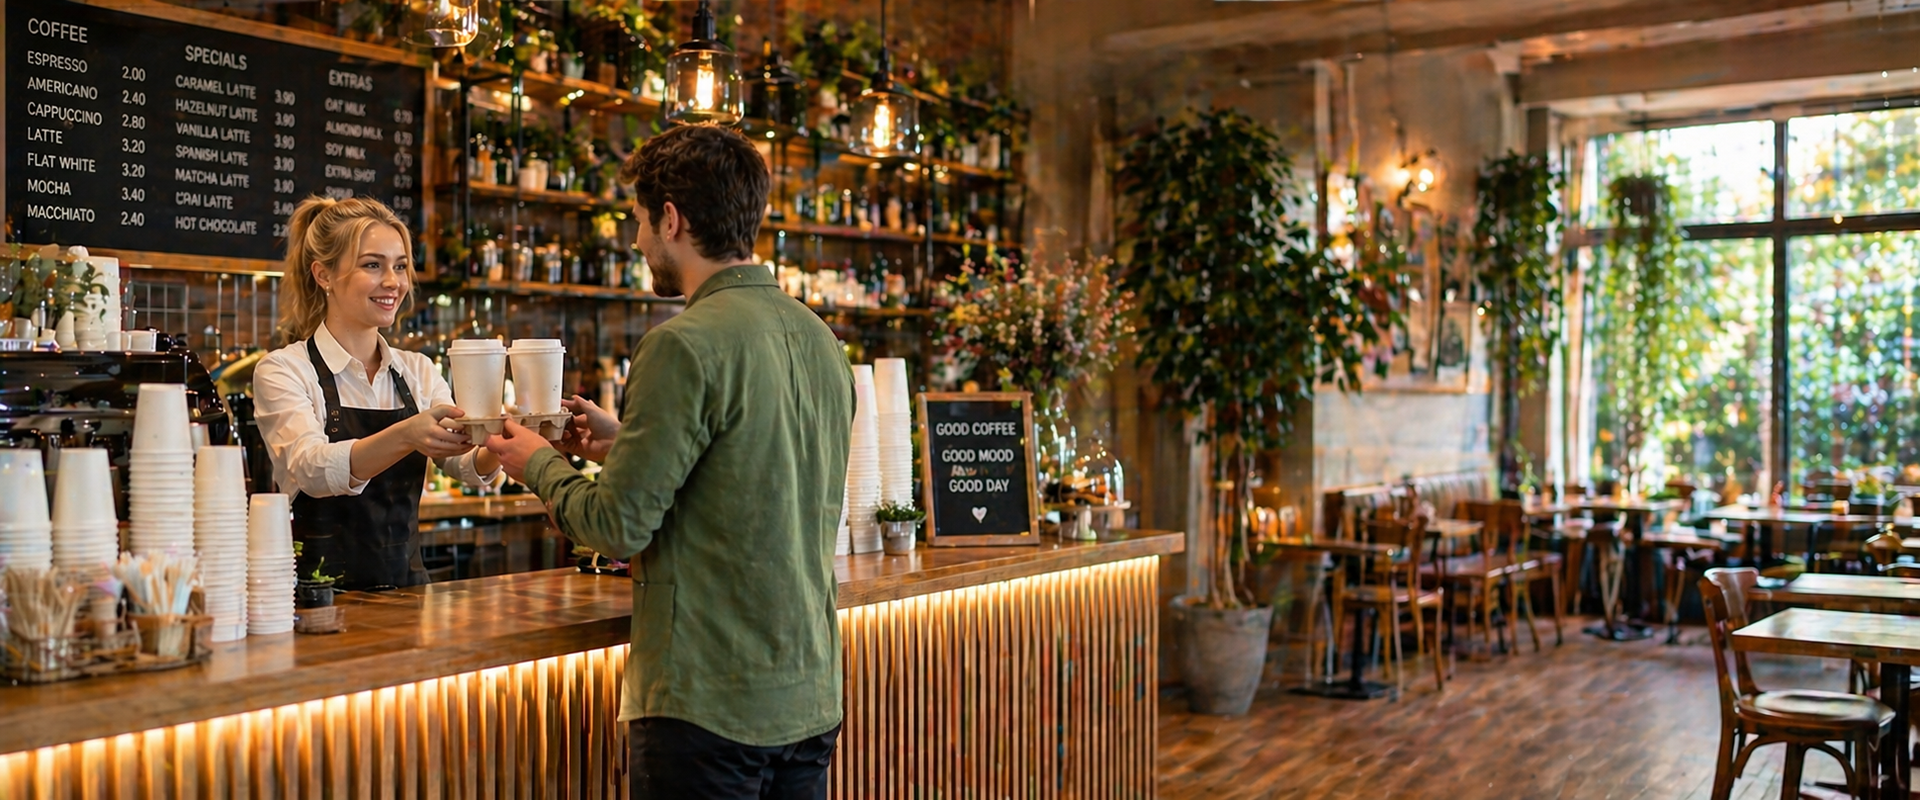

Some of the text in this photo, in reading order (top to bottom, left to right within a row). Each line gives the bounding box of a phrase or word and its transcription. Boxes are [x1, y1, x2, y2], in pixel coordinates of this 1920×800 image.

[28, 18, 87, 43] COFFEE
[28, 51, 145, 81] ESPRESSO 2.00
[185, 45, 247, 70] SPECIALS
[27, 77, 145, 105] AMERICANO 2.40
[176, 75, 224, 94] CARAMEL
[227, 83, 256, 99] LATTE
[329, 70, 372, 91] EXTRAS
[28, 102, 145, 129] CAPPUCCINO 2.80
[176, 99, 227, 117] HAZELNUT
[229, 106, 258, 122] LATTE
[345, 102, 365, 116] MILK
[28, 127, 145, 153] LATTE 3.20
[176, 123, 218, 139] VANILLA
[221, 128, 250, 143] LATTE
[176, 145, 218, 162] SPANISH
[221, 151, 248, 166] LATTE
[325, 142, 343, 156] SOY
[28, 153, 145, 178] FLAT WHITE 3.20
[175, 168, 218, 184] MATCHA
[220, 173, 249, 188] LATTE
[28, 179, 145, 201] MOCHA 3.40
[204, 195, 233, 209] LATTE
[28, 204, 144, 226] MACCHIATO 2.40
[176, 216, 197, 230] HOT
[199, 218, 257, 234] CHOCOLATE
[936, 422, 1016, 436] GOOD COFFEE
[942, 449, 1014, 462] GOOD MOOD
[949, 479, 1009, 492] GOOD DAY
